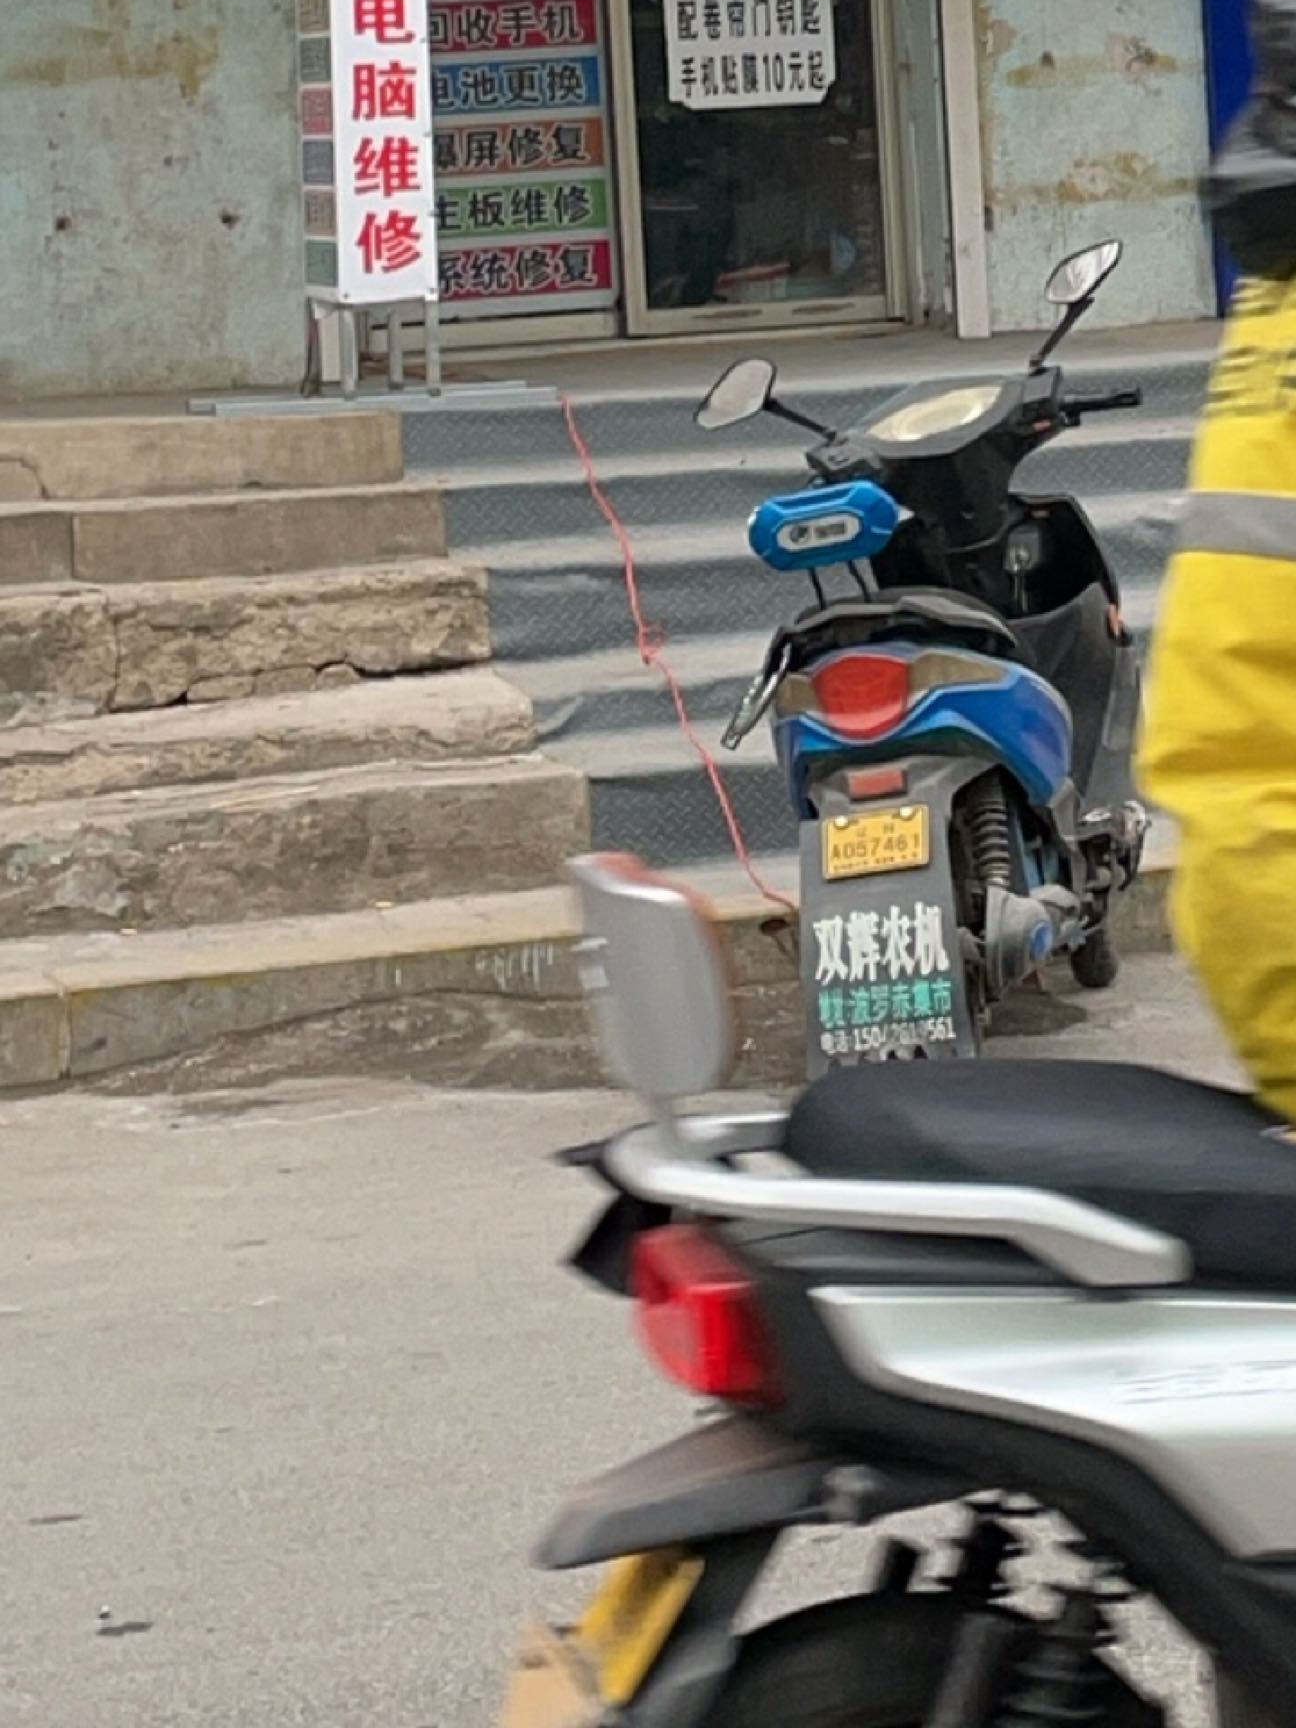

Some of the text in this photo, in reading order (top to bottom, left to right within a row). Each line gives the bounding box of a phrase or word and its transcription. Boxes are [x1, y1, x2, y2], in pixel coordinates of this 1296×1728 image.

[681, 50, 828, 99] 手机贴膜10元起
